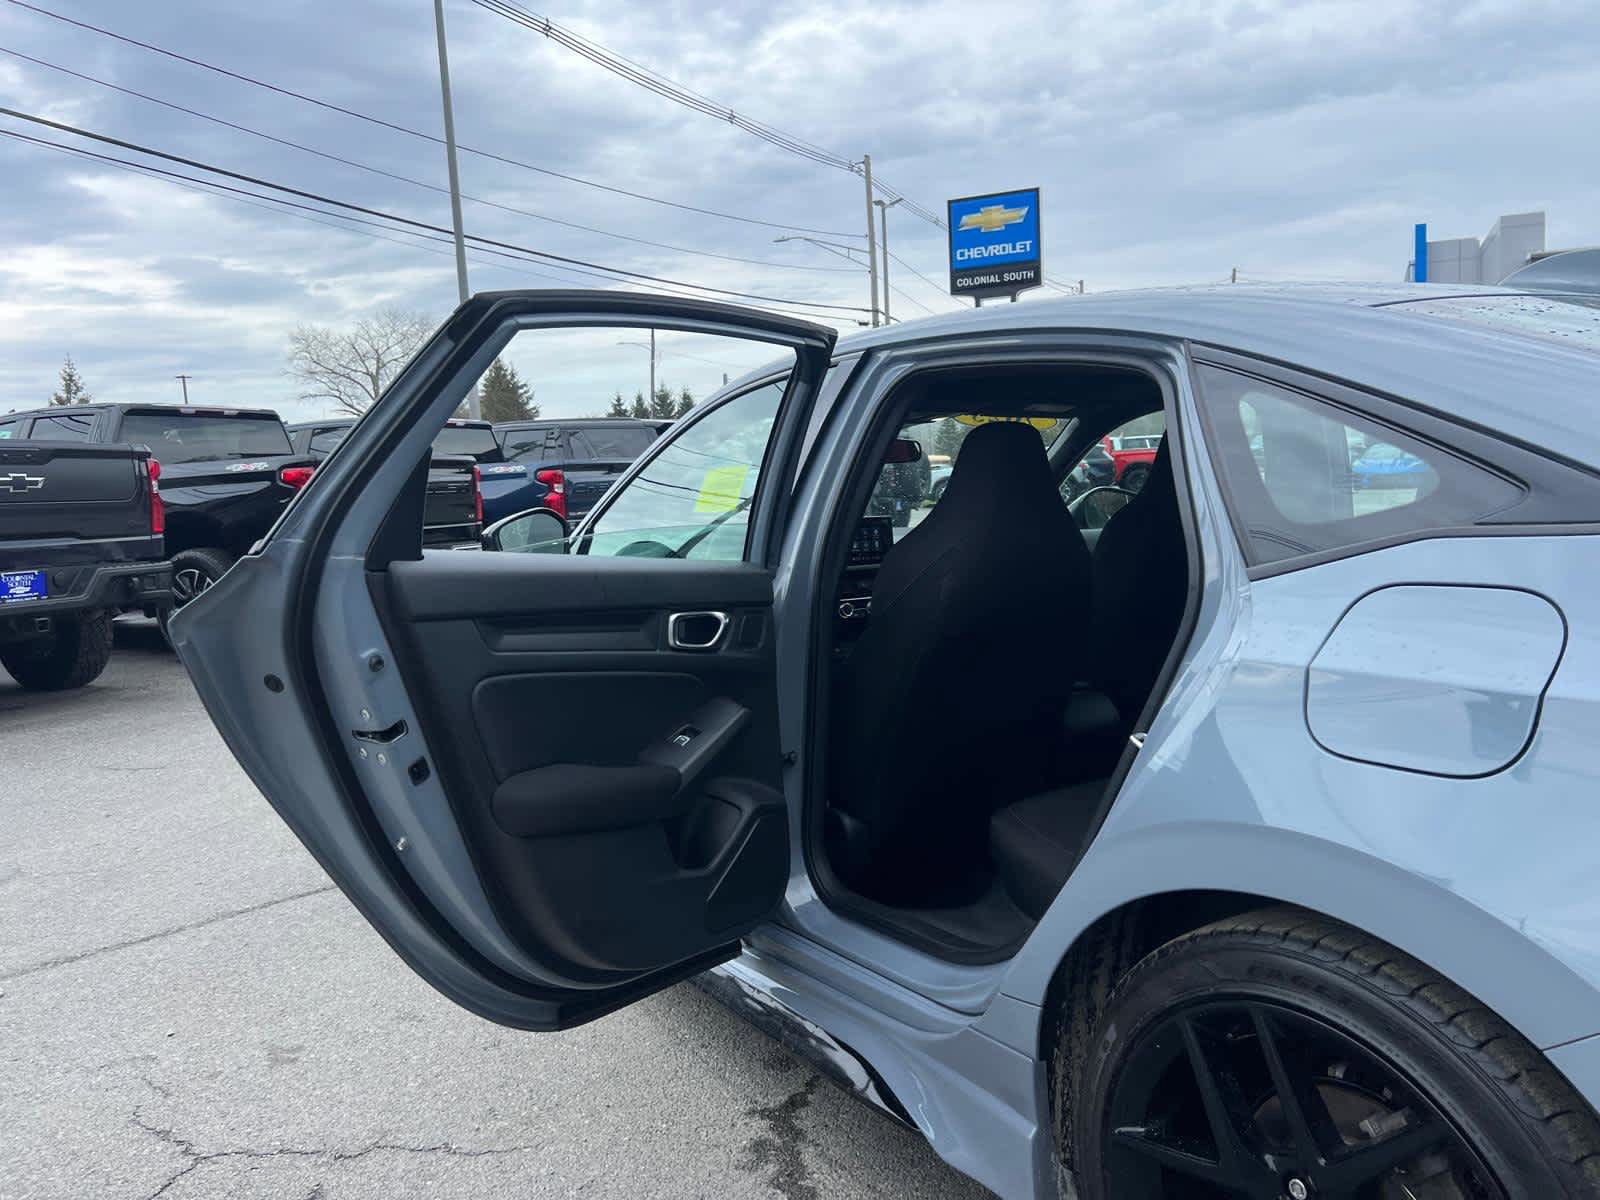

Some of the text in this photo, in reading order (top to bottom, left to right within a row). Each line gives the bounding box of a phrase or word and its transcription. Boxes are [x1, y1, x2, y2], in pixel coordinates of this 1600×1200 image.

[956, 240, 1033, 260] CHEVROLET
[957, 270, 1034, 287] COLONIAL SOUTH
